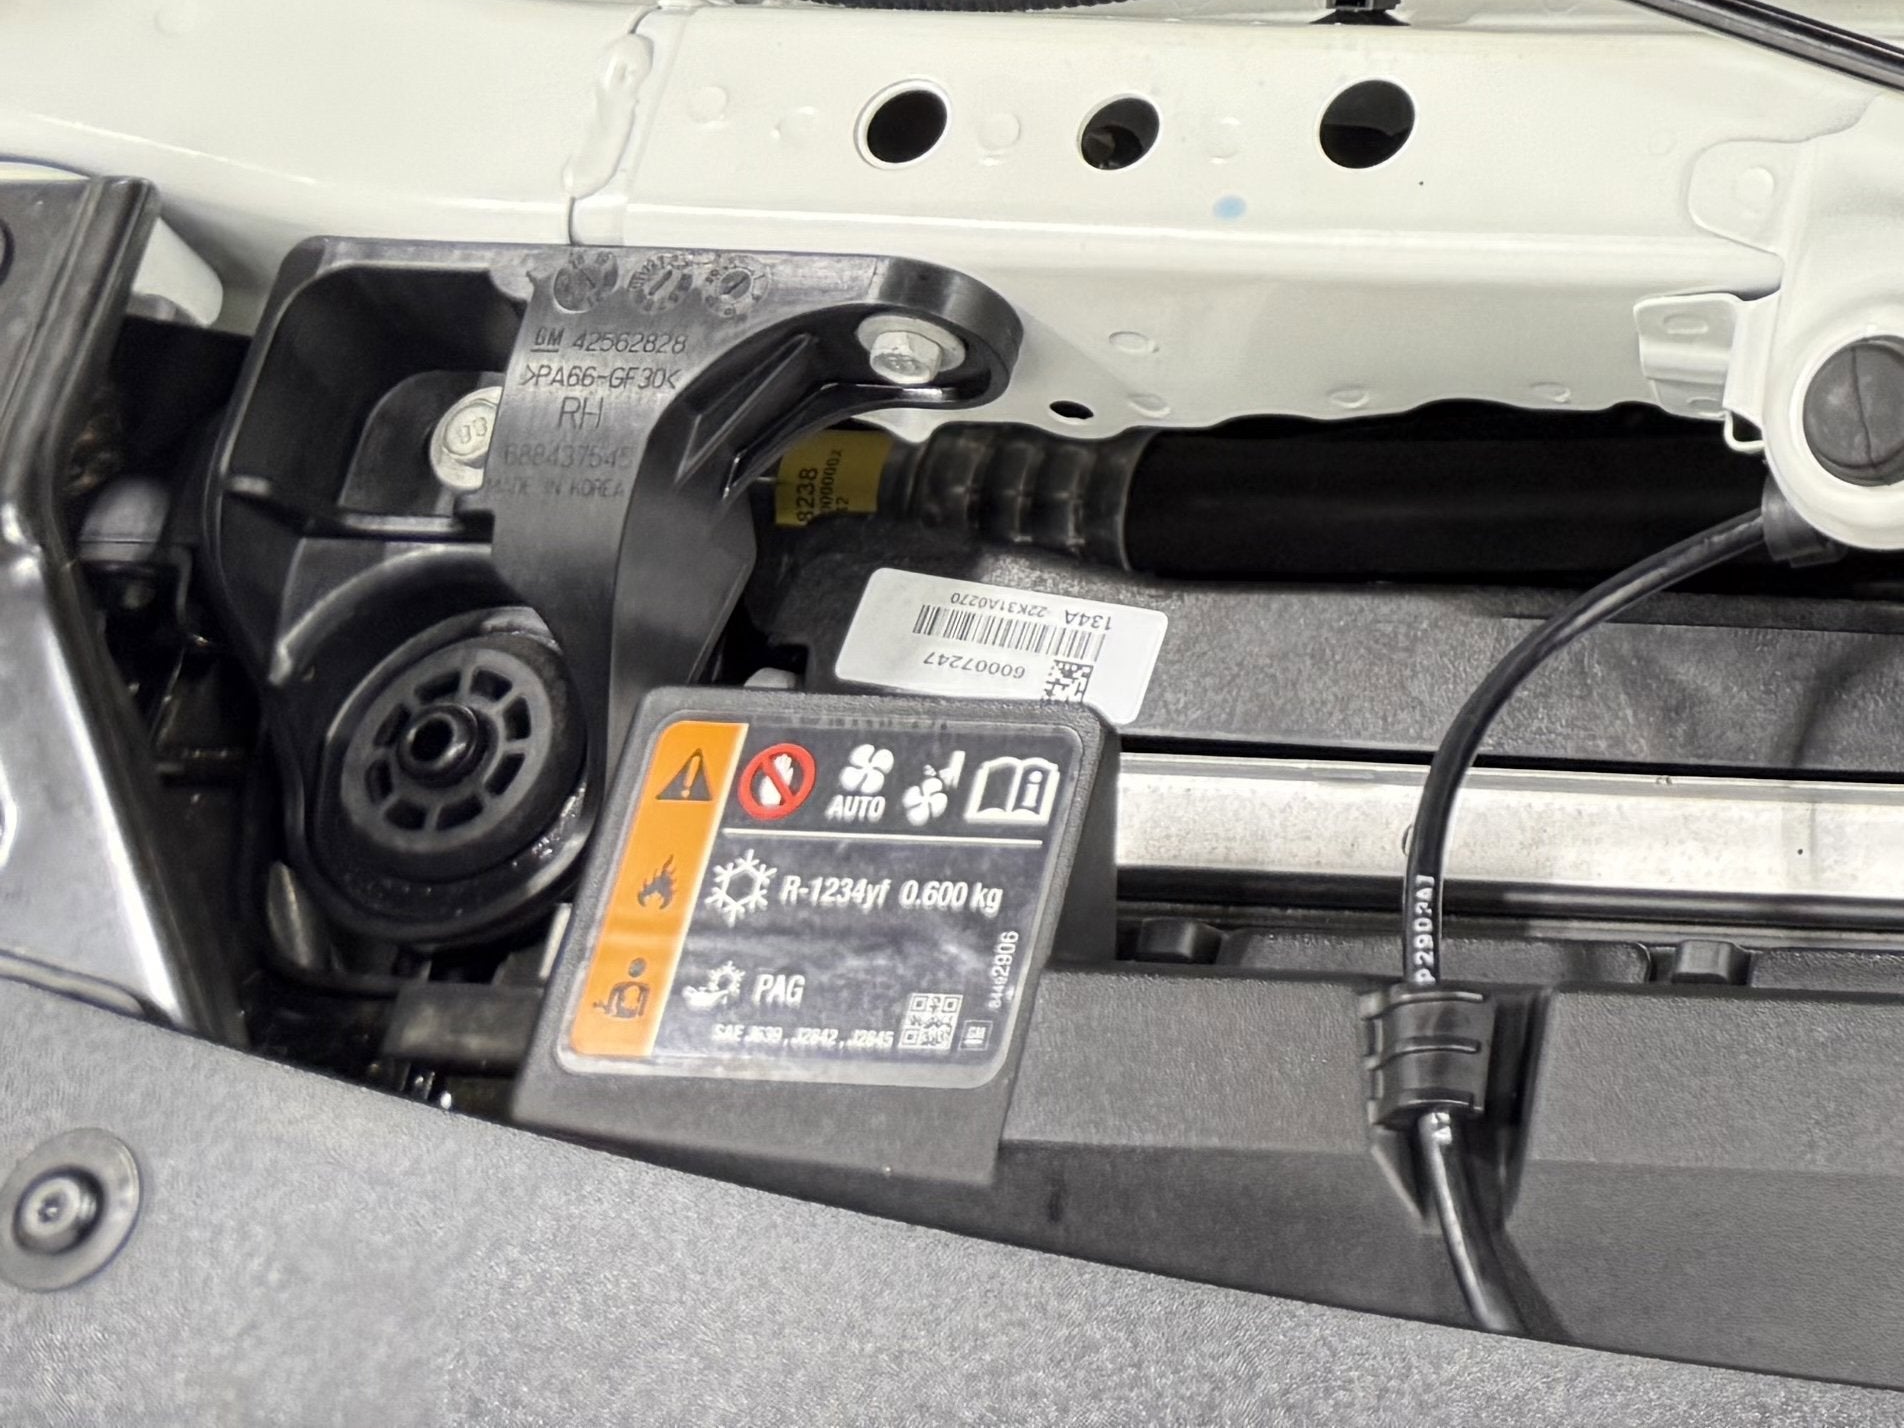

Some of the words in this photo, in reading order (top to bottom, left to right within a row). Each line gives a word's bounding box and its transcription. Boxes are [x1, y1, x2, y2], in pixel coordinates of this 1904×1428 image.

[533, 327, 564, 353] GM
[572, 332, 687, 354] 42562828
[557, 396, 604, 430] RH
[569, 480, 626, 499] KOREA
[950, 592, 1047, 618] 22K31A0270
[1064, 609, 1112, 632] 134A
[922, 650, 1026, 680] 60007247
[826, 795, 888, 823] AUTO
[779, 876, 890, 912] R-1234yf
[900, 878, 967, 908] 0.600
[969, 880, 1003, 918] kg
[752, 973, 805, 1006] PAG
[710, 1022, 744, 1043] SAE
